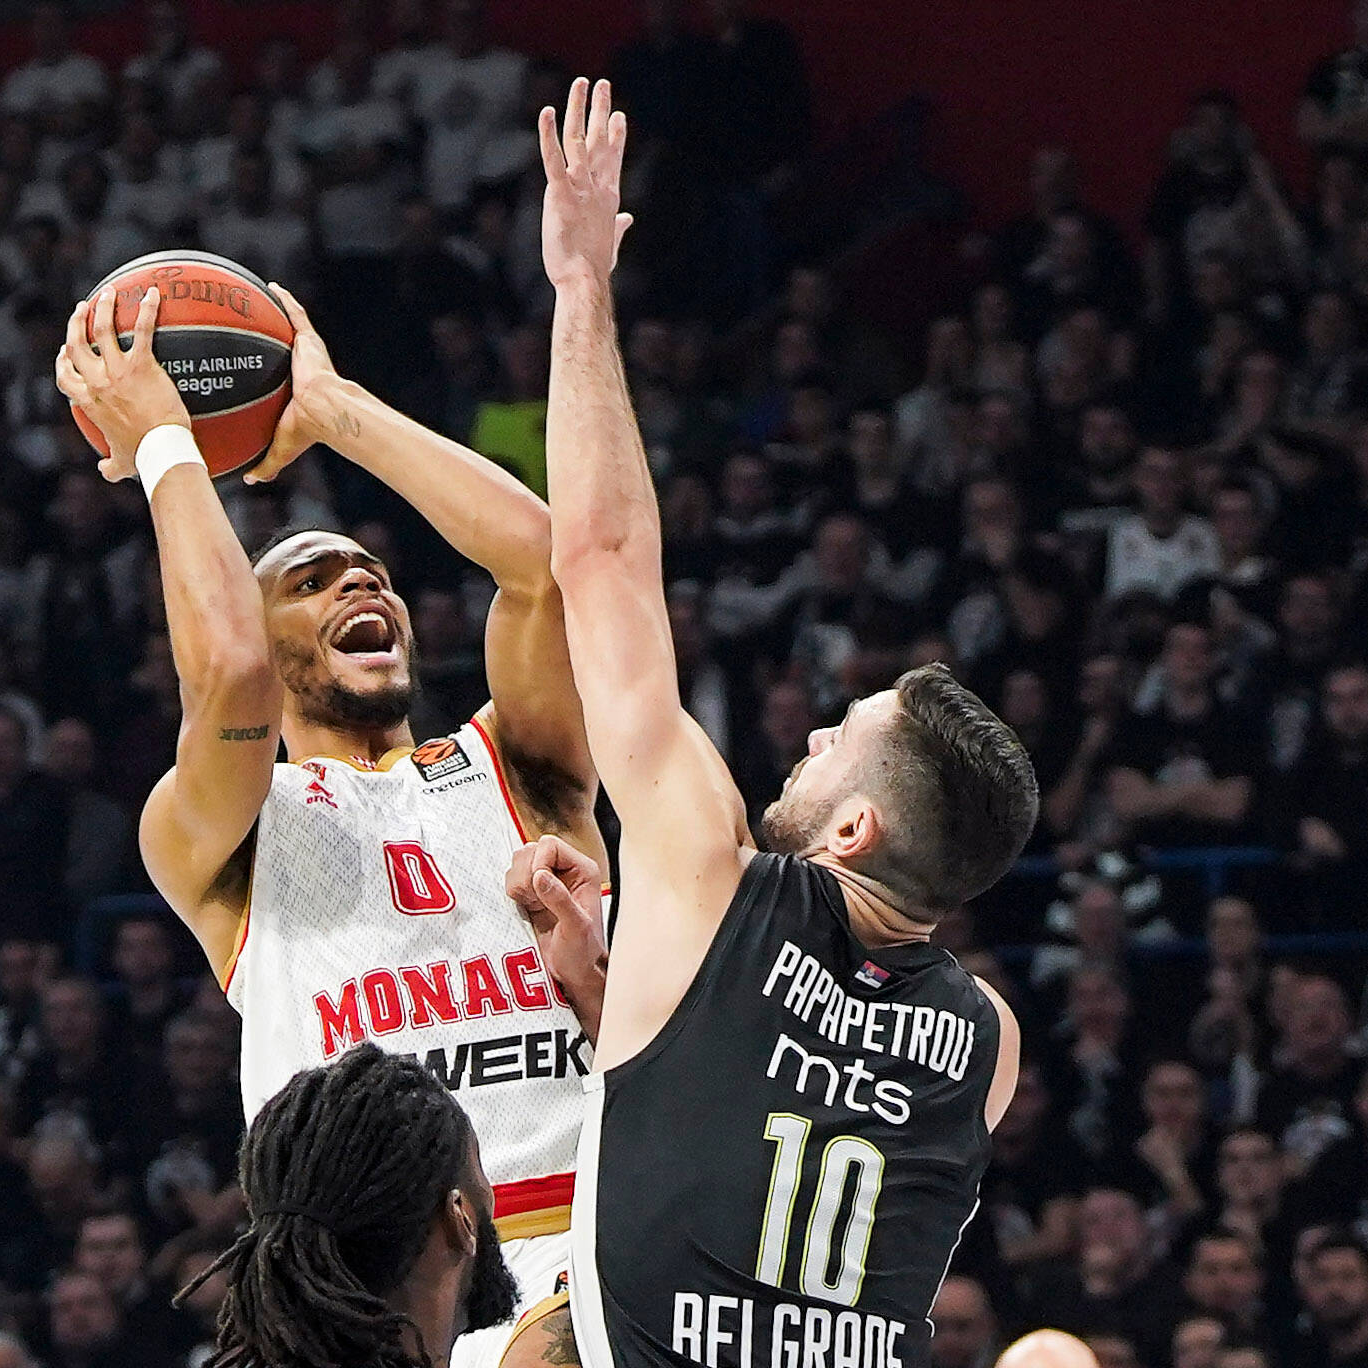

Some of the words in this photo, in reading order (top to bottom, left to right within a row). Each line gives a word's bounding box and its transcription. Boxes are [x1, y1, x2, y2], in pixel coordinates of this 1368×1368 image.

[159, 360, 193, 374] ISH
[198, 355, 263, 372] AIRLINES
[177, 376, 234, 395] eague
[422, 771, 488, 796] oneteam
[383, 839, 457, 916] 0
[762, 940, 975, 1082] PAPAPETROU
[767, 1033, 913, 1125] mts
[755, 1112, 885, 1307] 10
